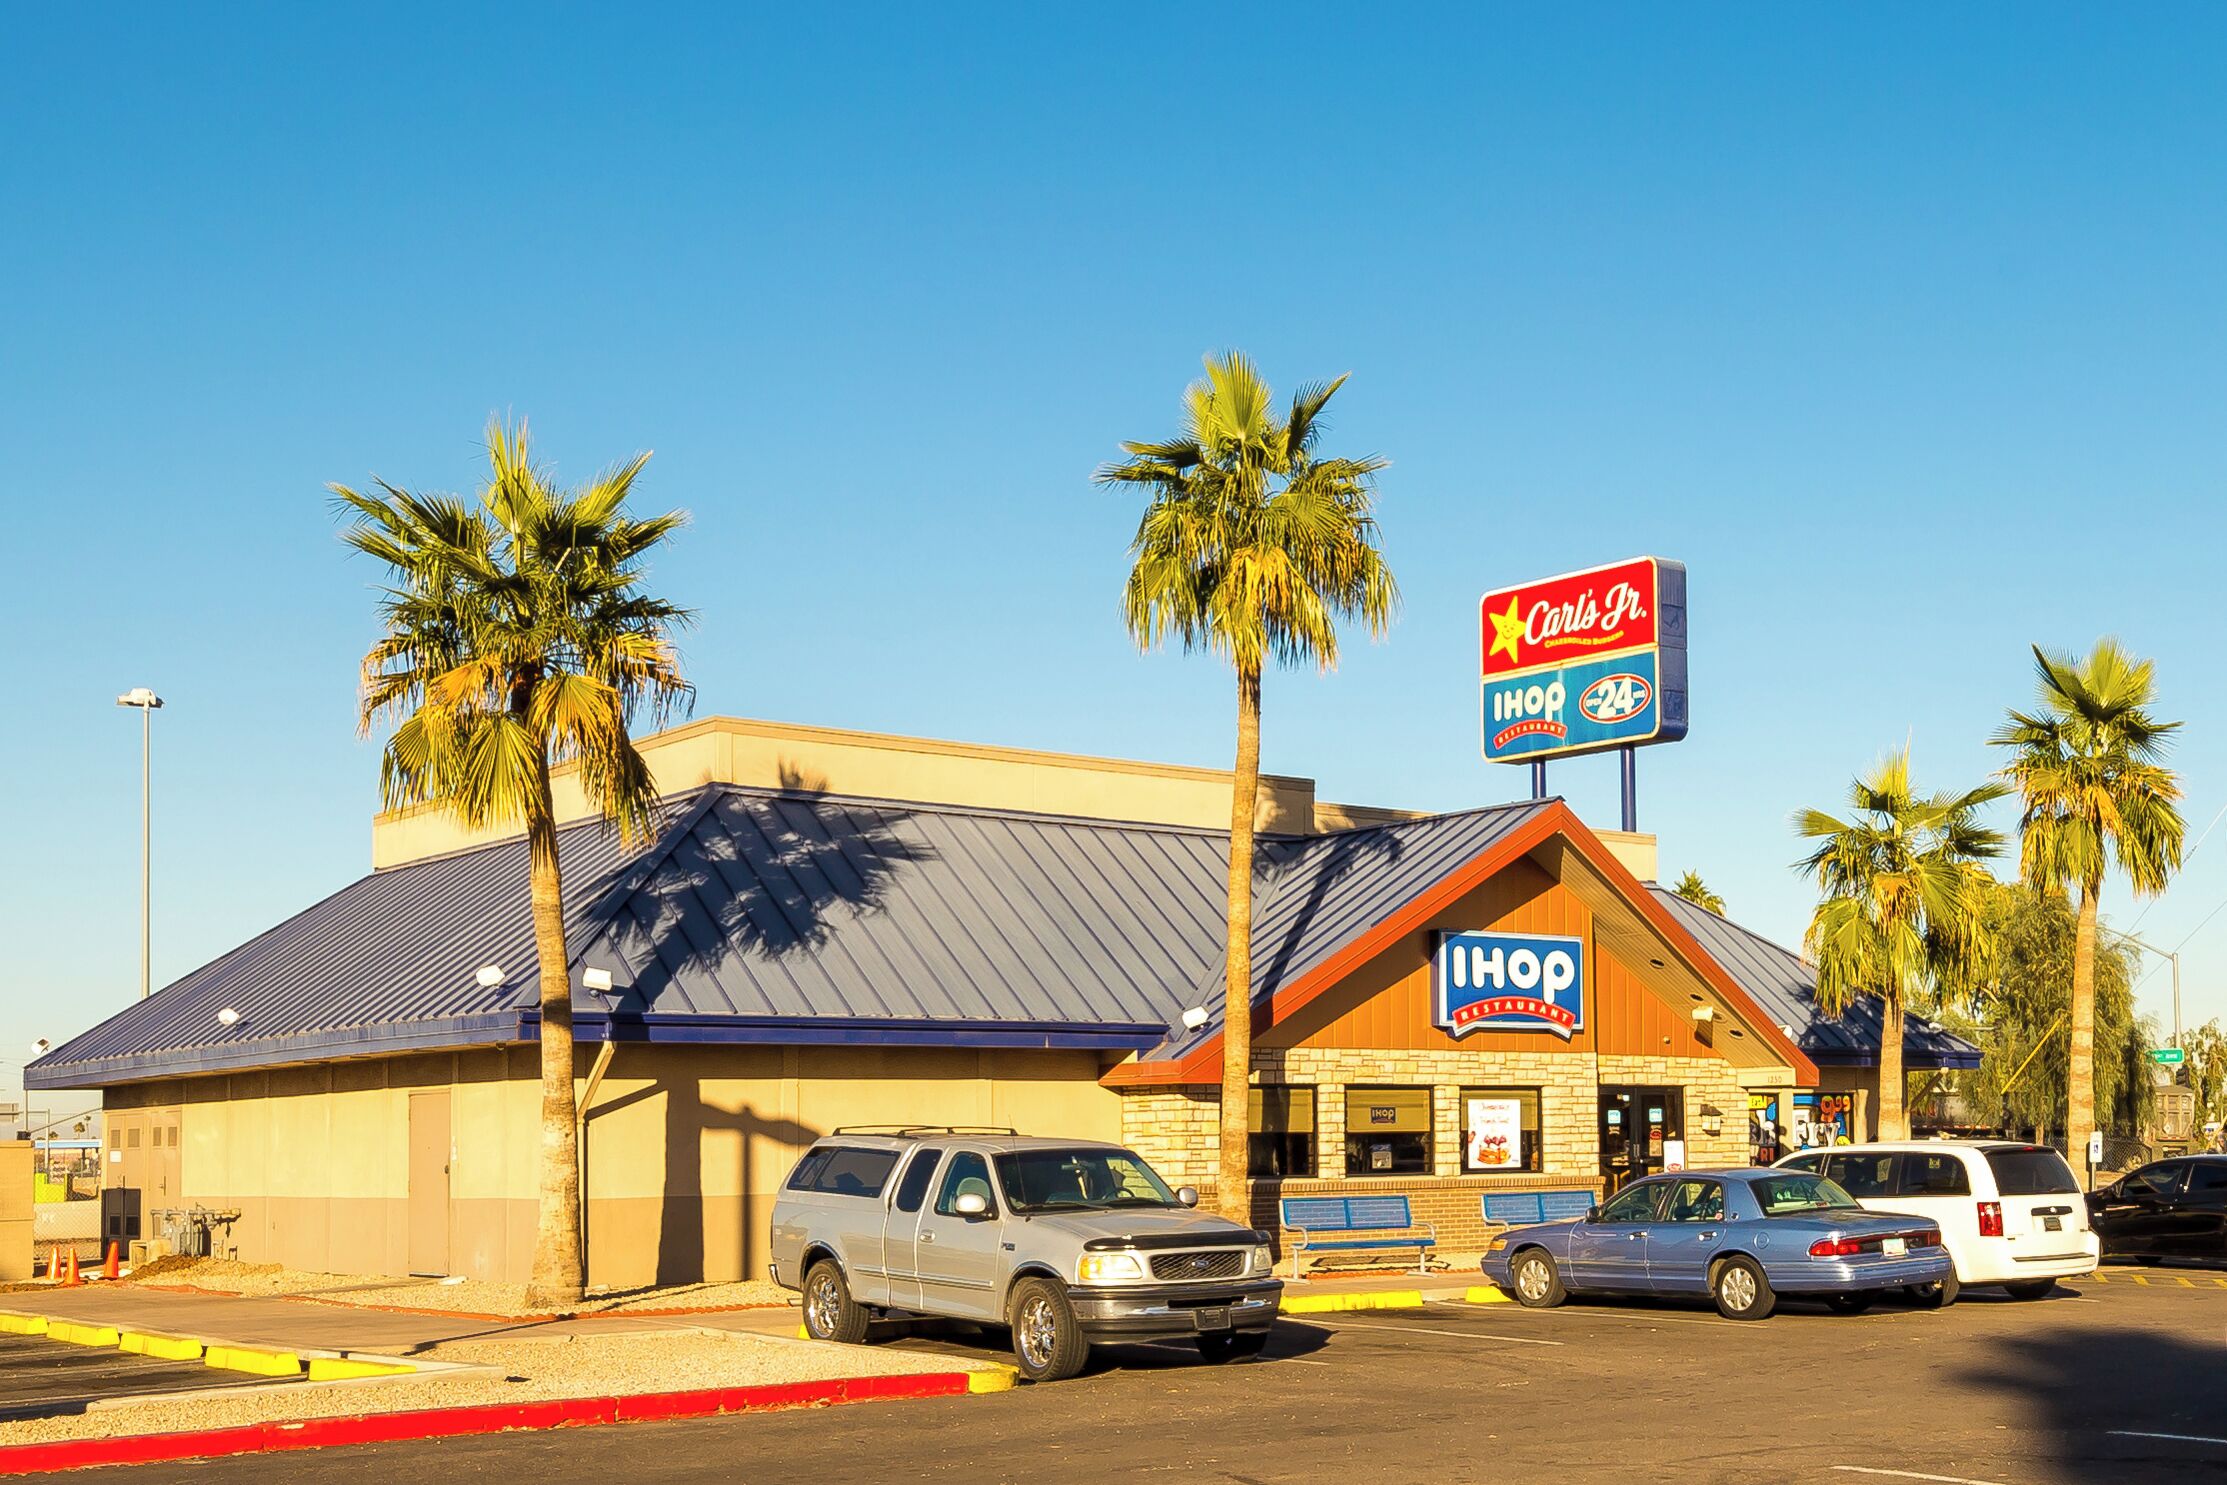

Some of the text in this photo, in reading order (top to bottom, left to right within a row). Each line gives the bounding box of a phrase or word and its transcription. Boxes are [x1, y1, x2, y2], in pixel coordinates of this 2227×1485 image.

[1524, 582, 1647, 645] Carl's Jr.
[1494, 681, 1566, 723] IHOP
[1597, 676, 1635, 720] 24
[1498, 722, 1563, 744] RESTAURANT
[1453, 945, 1575, 1005] IHOP
[1460, 1000, 1569, 1023] RESTAURANT
[1372, 1108, 1395, 1120] IHOP
